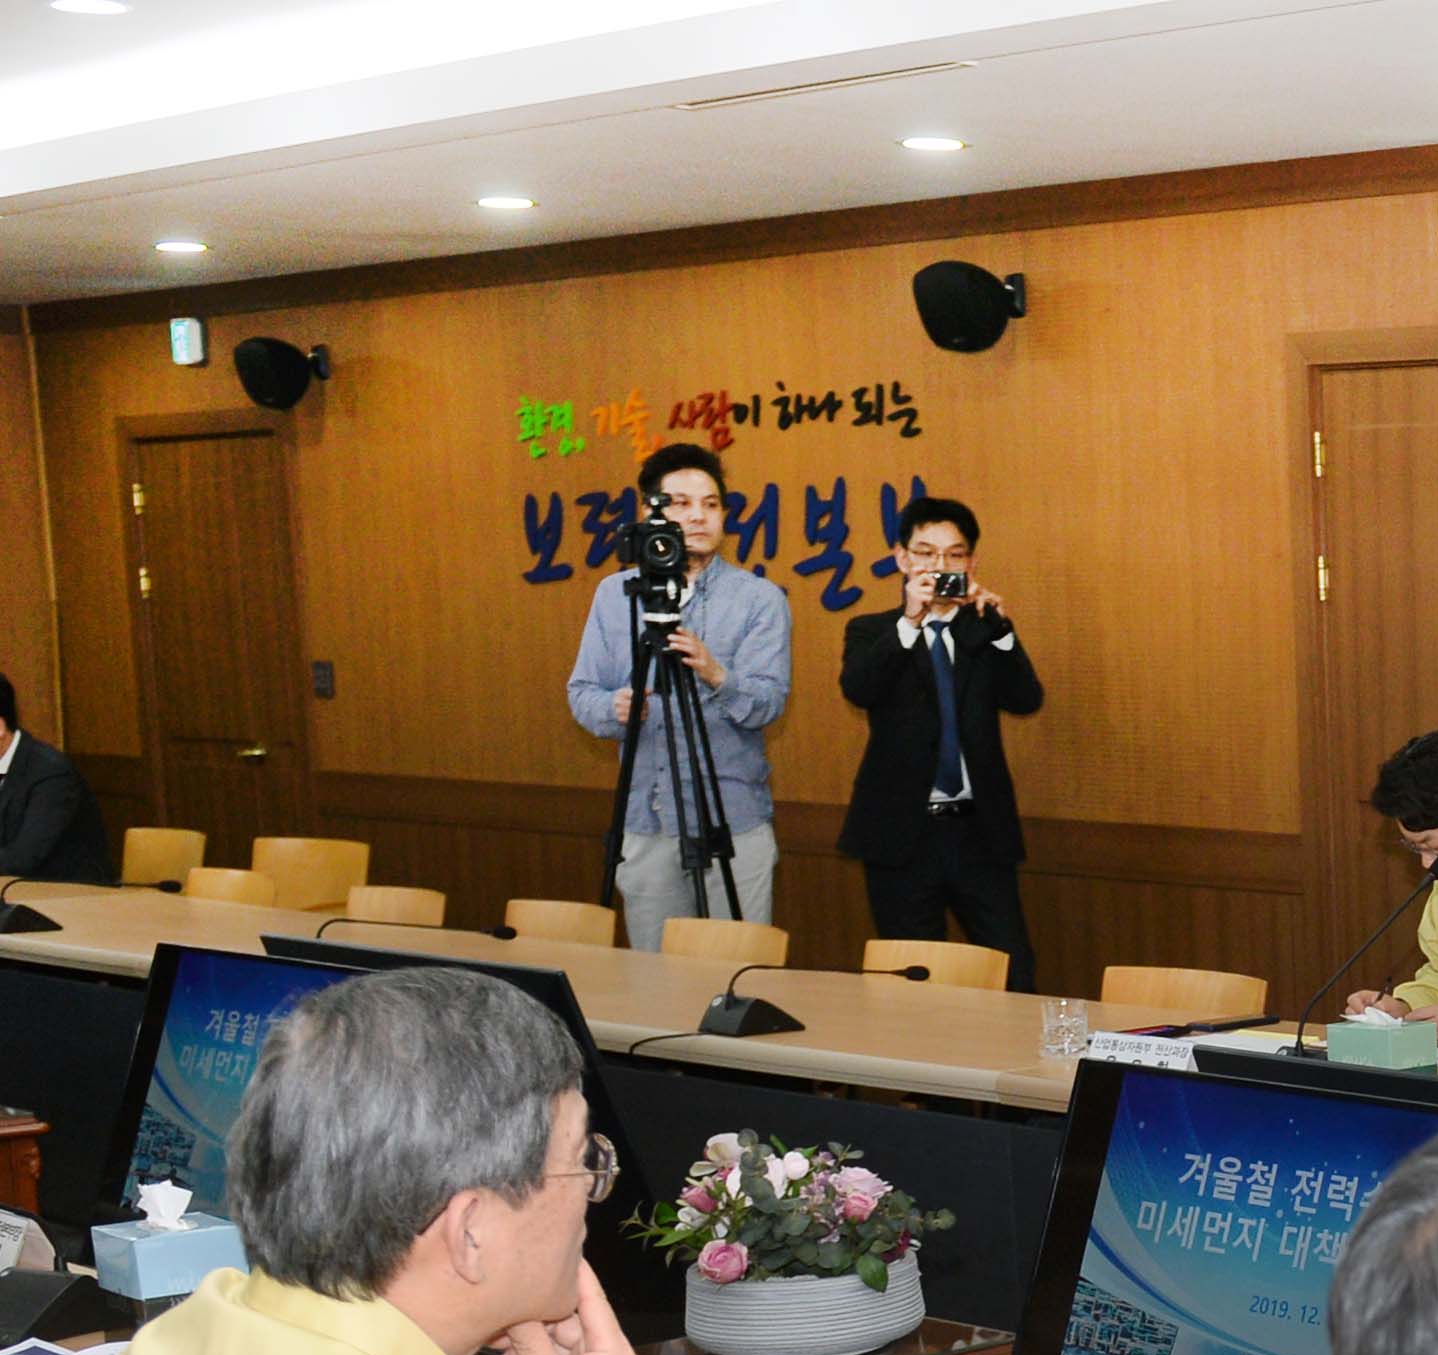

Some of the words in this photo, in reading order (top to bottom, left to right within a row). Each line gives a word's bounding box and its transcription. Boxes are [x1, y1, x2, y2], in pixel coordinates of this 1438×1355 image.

[668, 388, 761, 451] 사람이
[771, 381, 843, 430] 하나
[851, 381, 922, 438] 되는
[204, 1008, 261, 1047] 겨울철
[179, 1044, 250, 1086] 미세먼지
[1178, 1152, 1279, 1209] 겨울철
[1136, 1200, 1267, 1264] 미세먼지
[1249, 1295, 1293, 1321] 2019.
[1299, 1304, 1322, 1327] 12.
